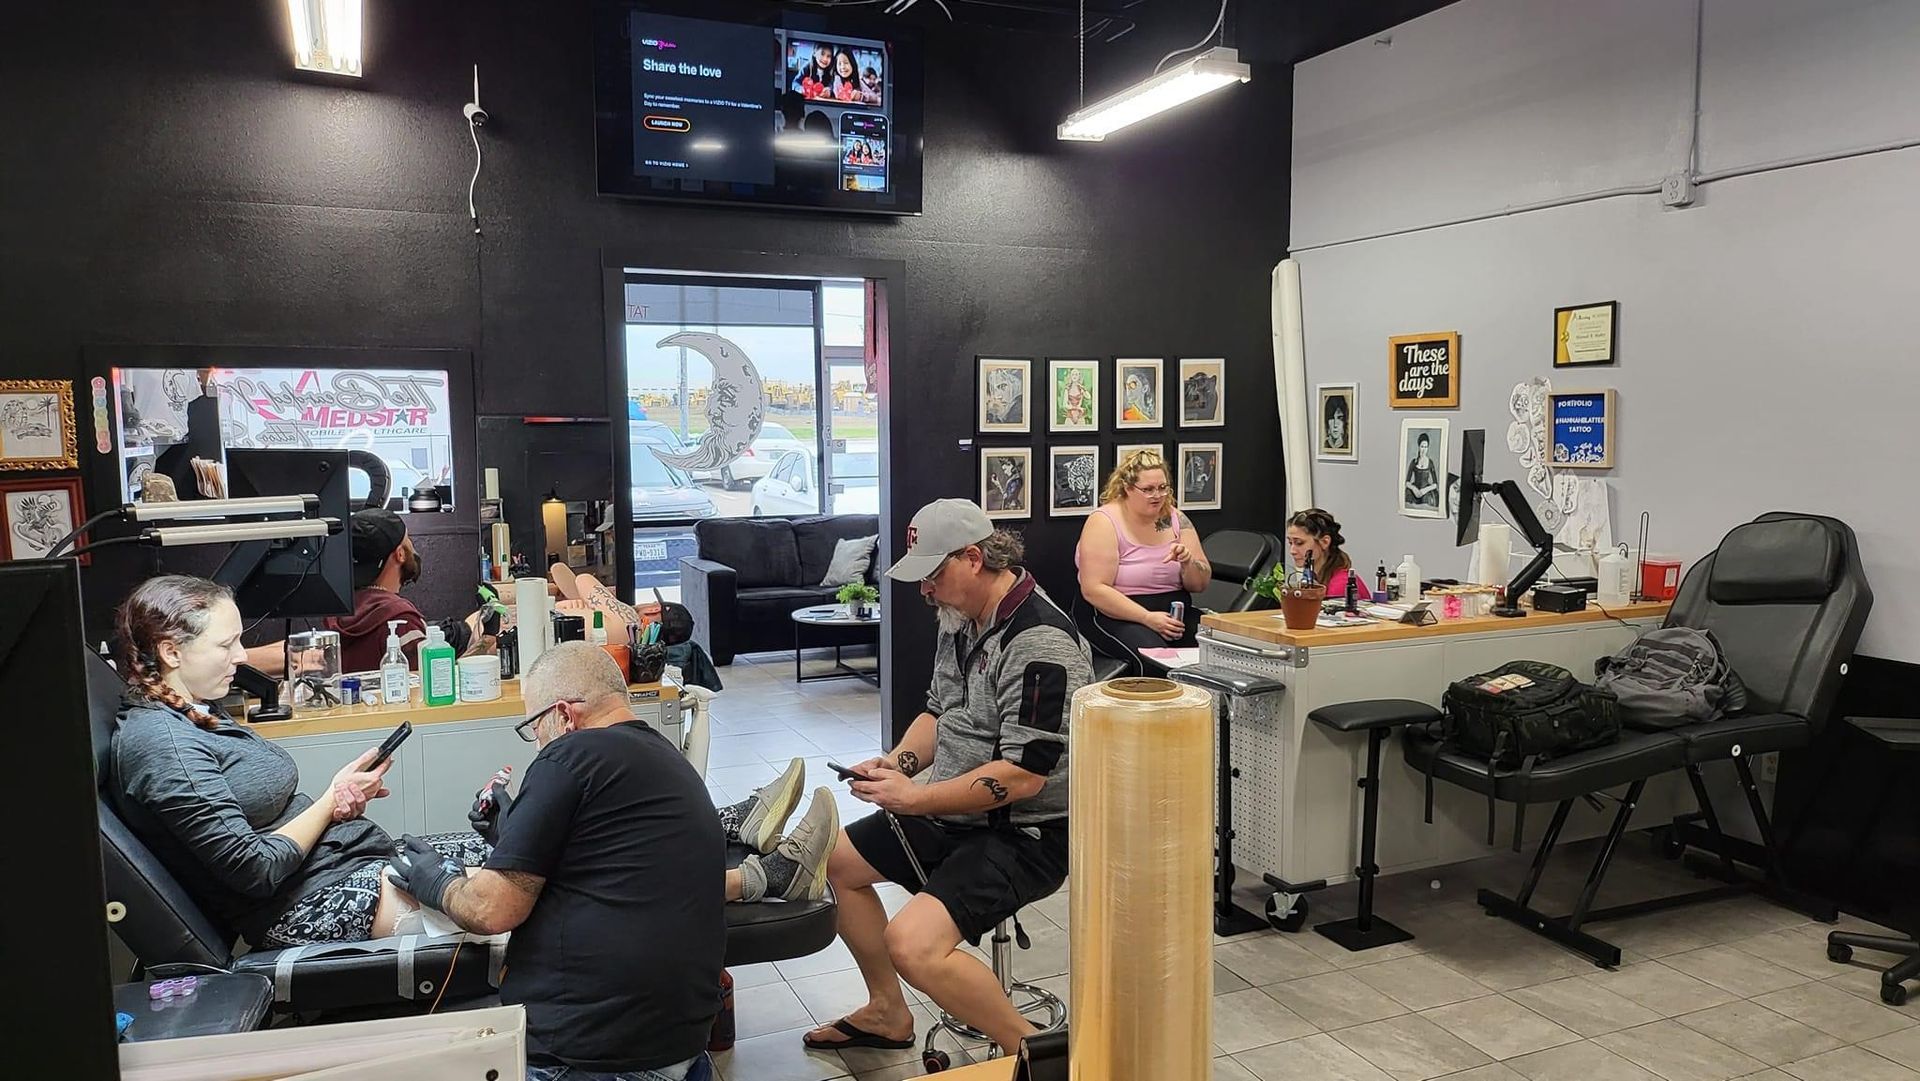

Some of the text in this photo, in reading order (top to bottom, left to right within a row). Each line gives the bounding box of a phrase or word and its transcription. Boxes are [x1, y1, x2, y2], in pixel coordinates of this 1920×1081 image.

[643, 58, 722, 78] Share the love
[1403, 344, 1447, 364] These
[1410, 359, 1450, 377] are the
[1399, 371, 1434, 399] days
[1558, 400, 1593, 408] PORTFOLIO
